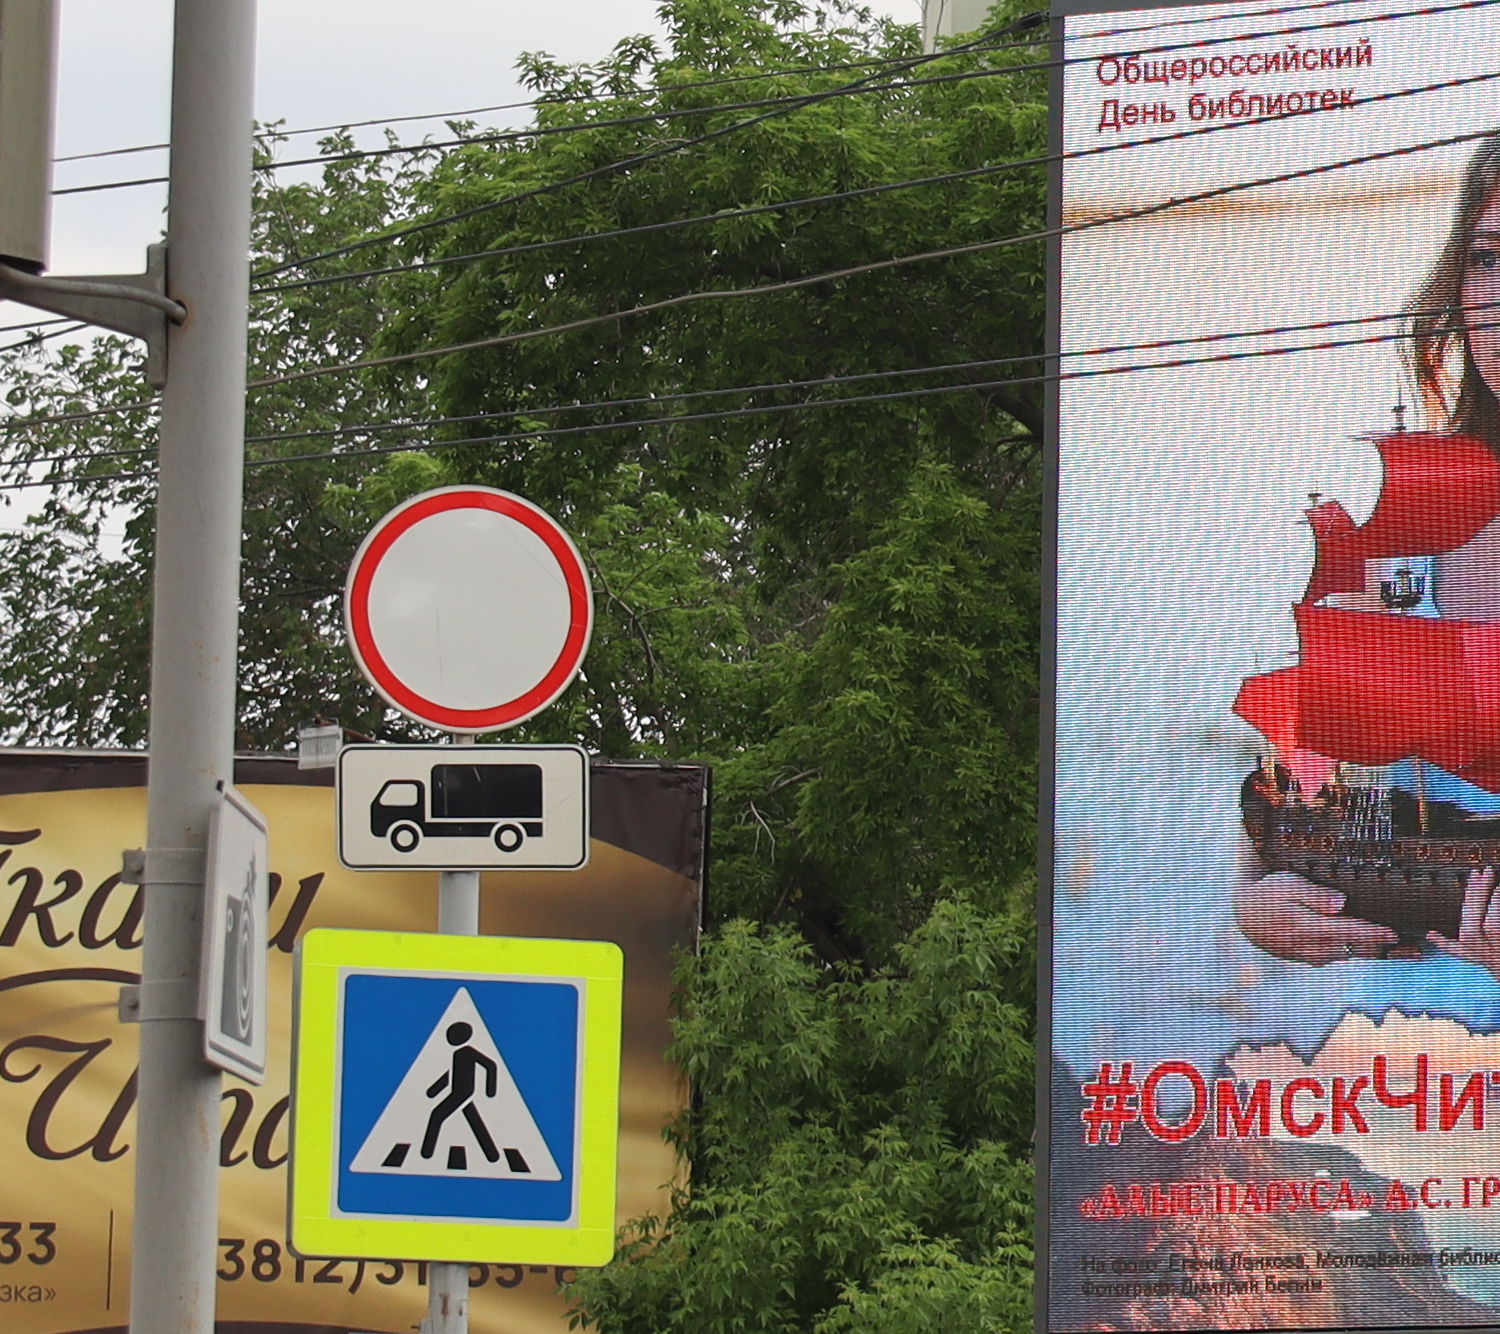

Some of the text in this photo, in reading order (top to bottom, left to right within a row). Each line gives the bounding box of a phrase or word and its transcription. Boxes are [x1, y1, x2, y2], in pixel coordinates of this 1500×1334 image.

[1097, 37, 1373, 86] Общероссийский
[1099, 88, 1355, 132] День библиотек
[1213, 1178, 1375, 1216] ПАРУСА»
